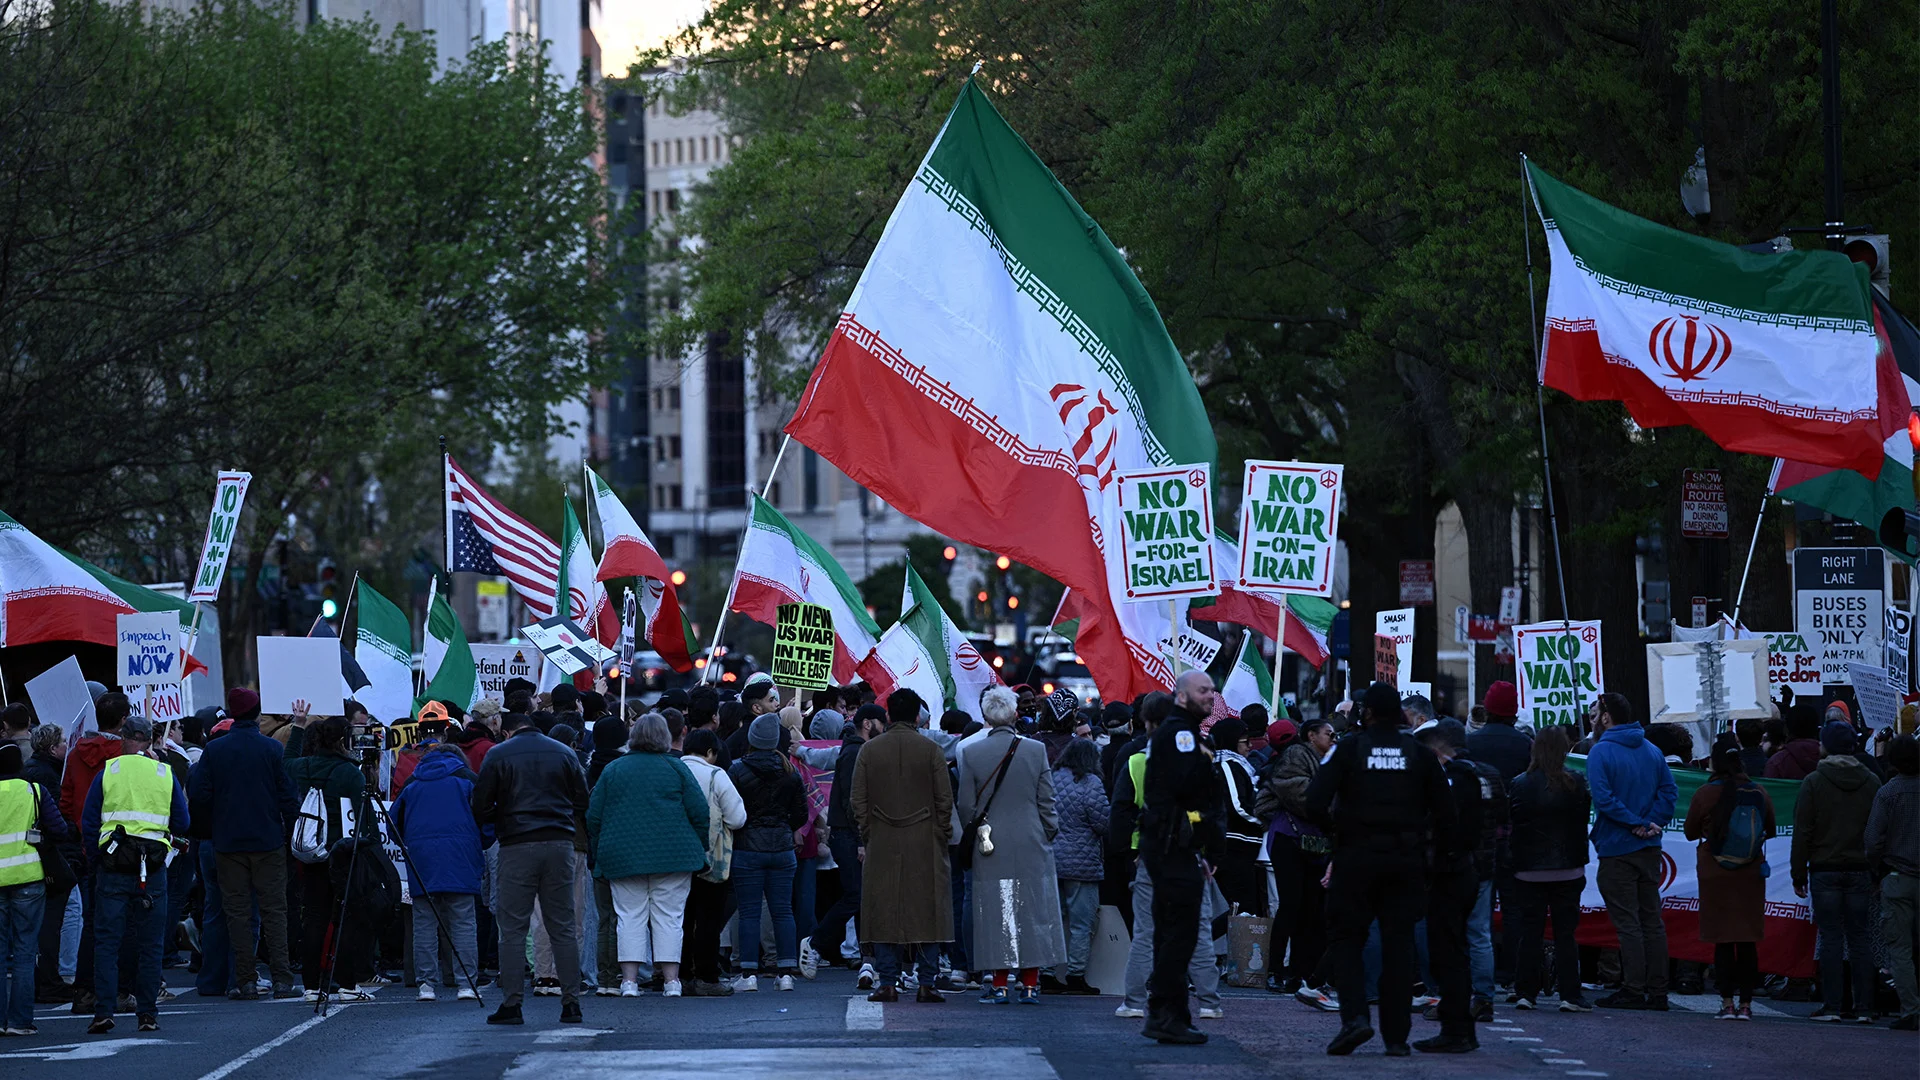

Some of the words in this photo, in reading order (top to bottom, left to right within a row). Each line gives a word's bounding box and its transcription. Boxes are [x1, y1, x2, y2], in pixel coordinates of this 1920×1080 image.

[1692, 472, 1721, 483] SNOW
[1138, 479, 1186, 509] NO
[1267, 474, 1317, 504] NO
[1685, 482, 1724, 491] EMERGENC
[1688, 490, 1724, 502] ROUTE
[1685, 502, 1695, 510] NO
[1698, 503, 1728, 512] PARKING
[1251, 500, 1328, 543] WAR
[1692, 511, 1718, 521] DURING
[1124, 510, 1207, 542] WAR
[1684, 521, 1727, 530] EMERGENCY
[1252, 552, 1315, 582] IRAN
[1821, 557, 1856, 568] RIGHT
[1132, 559, 1209, 587] ISRAEL
[1824, 573, 1855, 584] LANE
[1813, 597, 1867, 611] BUSES
[779, 604, 799, 625] NO
[801, 605, 832, 629] NEW
[1384, 614, 1406, 624] SMASH
[1813, 614, 1867, 628] BIKES
[1886, 608, 1910, 634] NO
[120, 628, 171, 646] Impeach
[777, 625, 797, 641] US
[799, 627, 833, 645] WAR
[1380, 636, 1391, 650] NO
[142, 645, 167, 654] him
[775, 644, 794, 659] IN
[796, 647, 831, 664] THE
[1536, 634, 1580, 662] NO
[128, 652, 174, 677] NOW
[475, 657, 506, 675] efend
[510, 664, 531, 676] our
[1376, 650, 1395, 666] WAR
[1794, 654, 1816, 668] for
[774, 659, 806, 677] MIDDLE
[808, 663, 830, 680] EAST
[1523, 661, 1597, 692] WAR
[1769, 665, 1821, 683] eedom
[1382, 747, 1401, 756] PARK
[1367, 755, 1407, 770] POLICE
